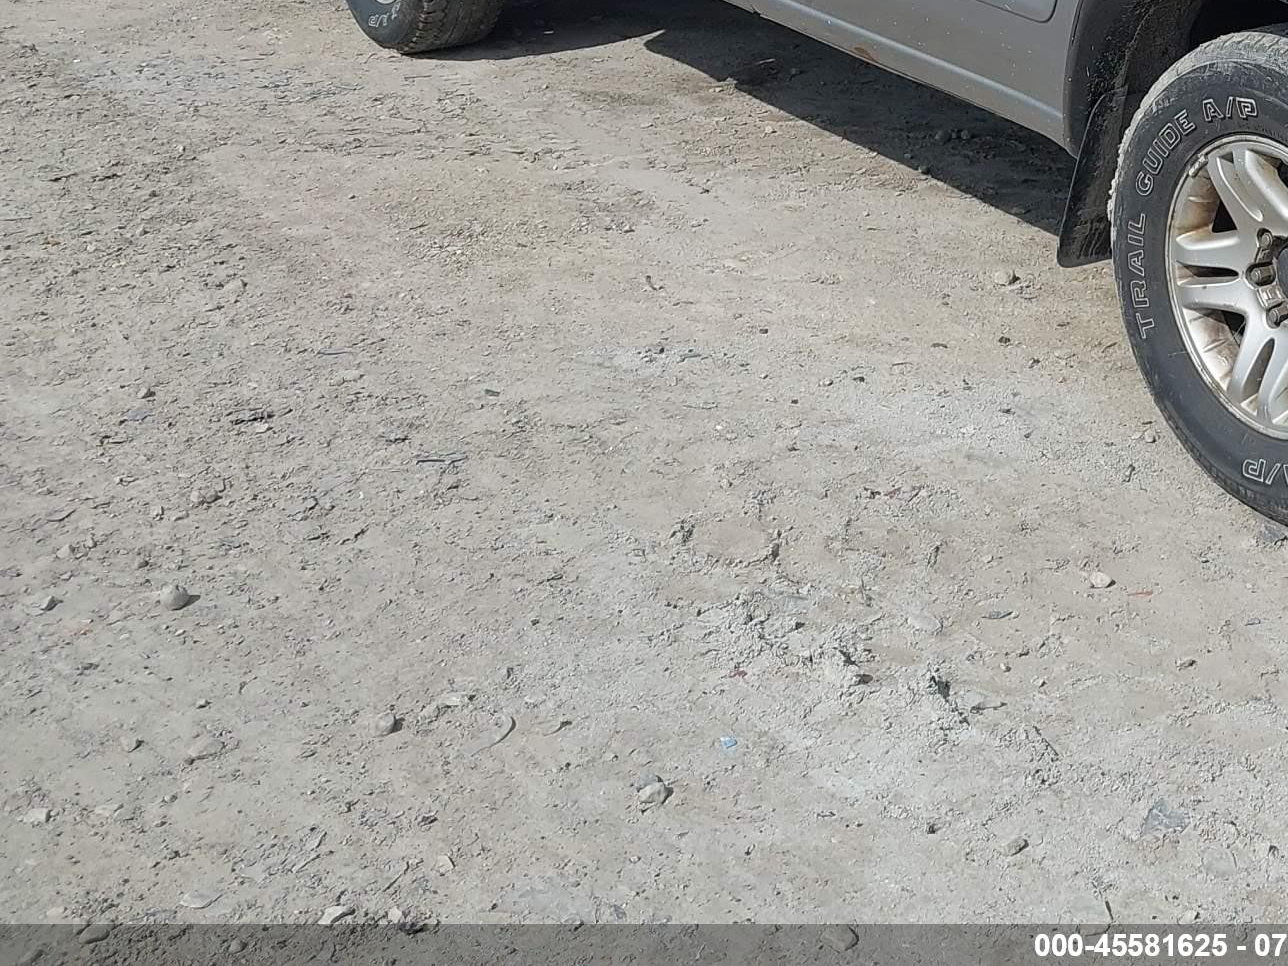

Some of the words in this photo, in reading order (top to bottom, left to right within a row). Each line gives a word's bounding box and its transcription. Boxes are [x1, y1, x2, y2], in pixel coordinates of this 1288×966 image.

[1135, 109, 1197, 196] GUIDE
[1202, 96, 1259, 122] A/P
[1128, 213, 1155, 340] TRAIL
